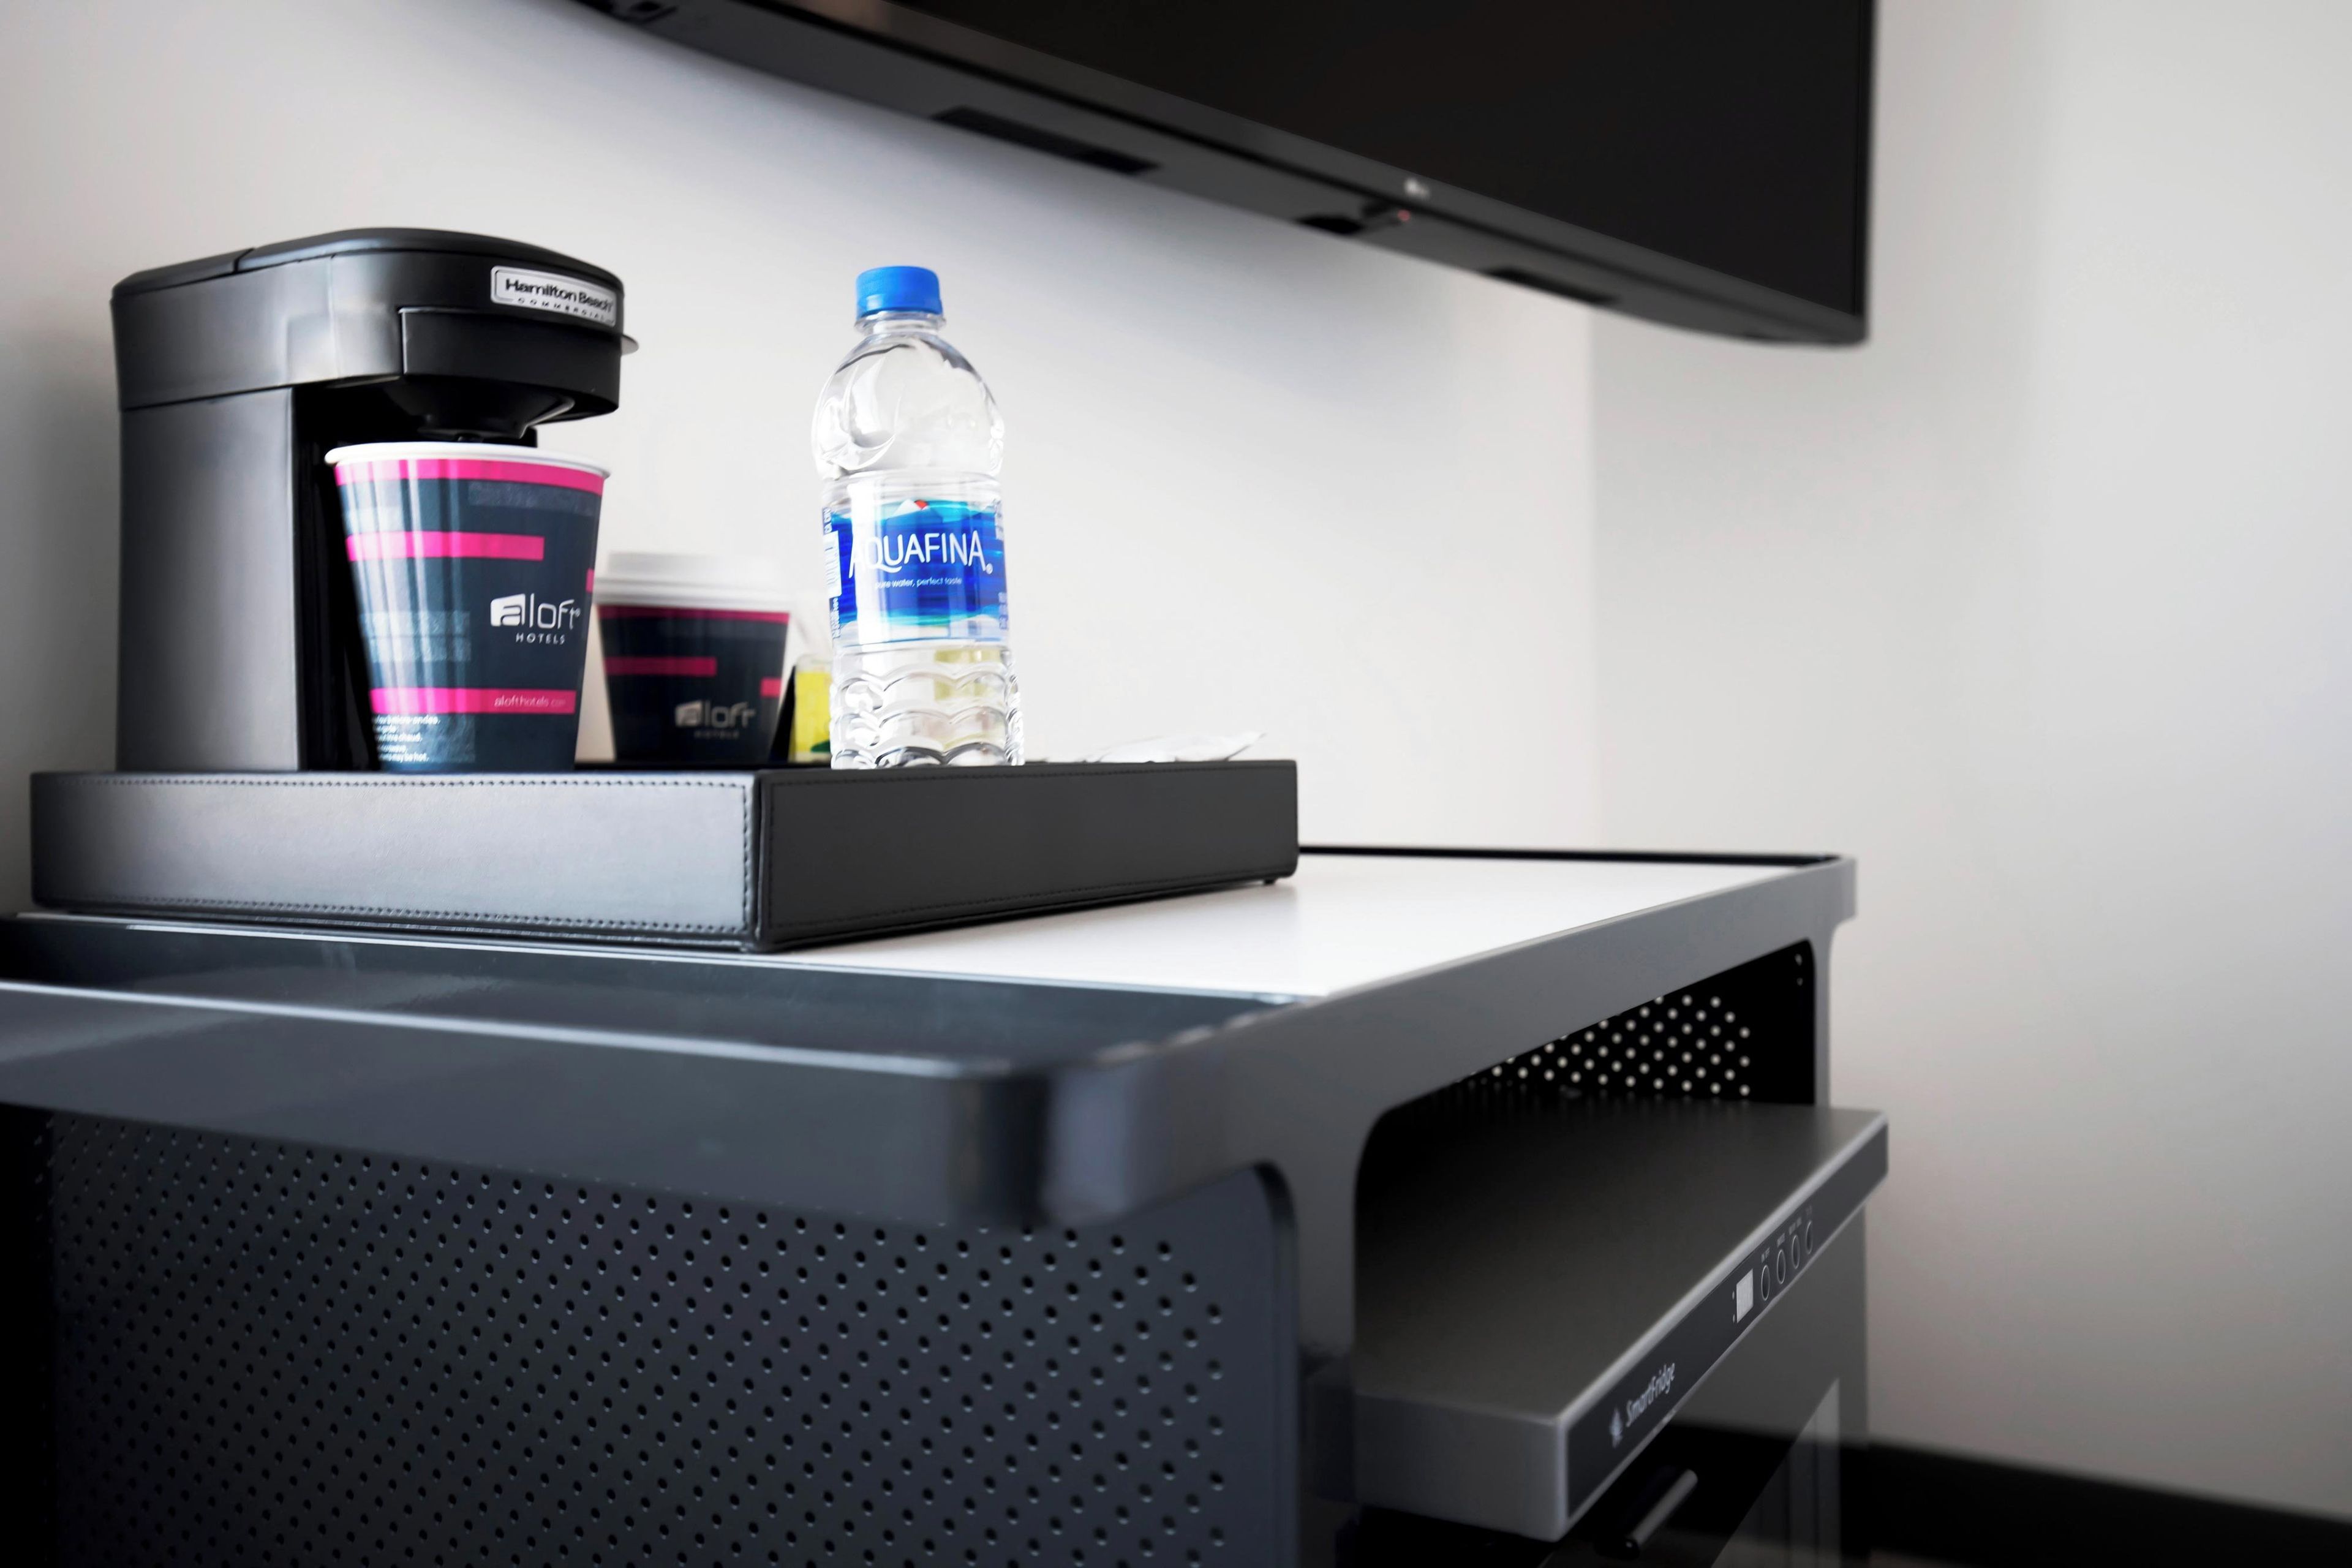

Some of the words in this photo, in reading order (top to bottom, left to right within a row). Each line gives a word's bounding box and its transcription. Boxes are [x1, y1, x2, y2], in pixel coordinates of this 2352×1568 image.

[505, 278, 577, 302] Hamilton
[578, 291, 613, 313] Beach
[518, 296, 603, 319] COMMERCIAL
[916, 577, 943, 587] perfect
[491, 592, 576, 630] aloft
[516, 632, 565, 645] HOTELS
[675, 699, 756, 728] aloft
